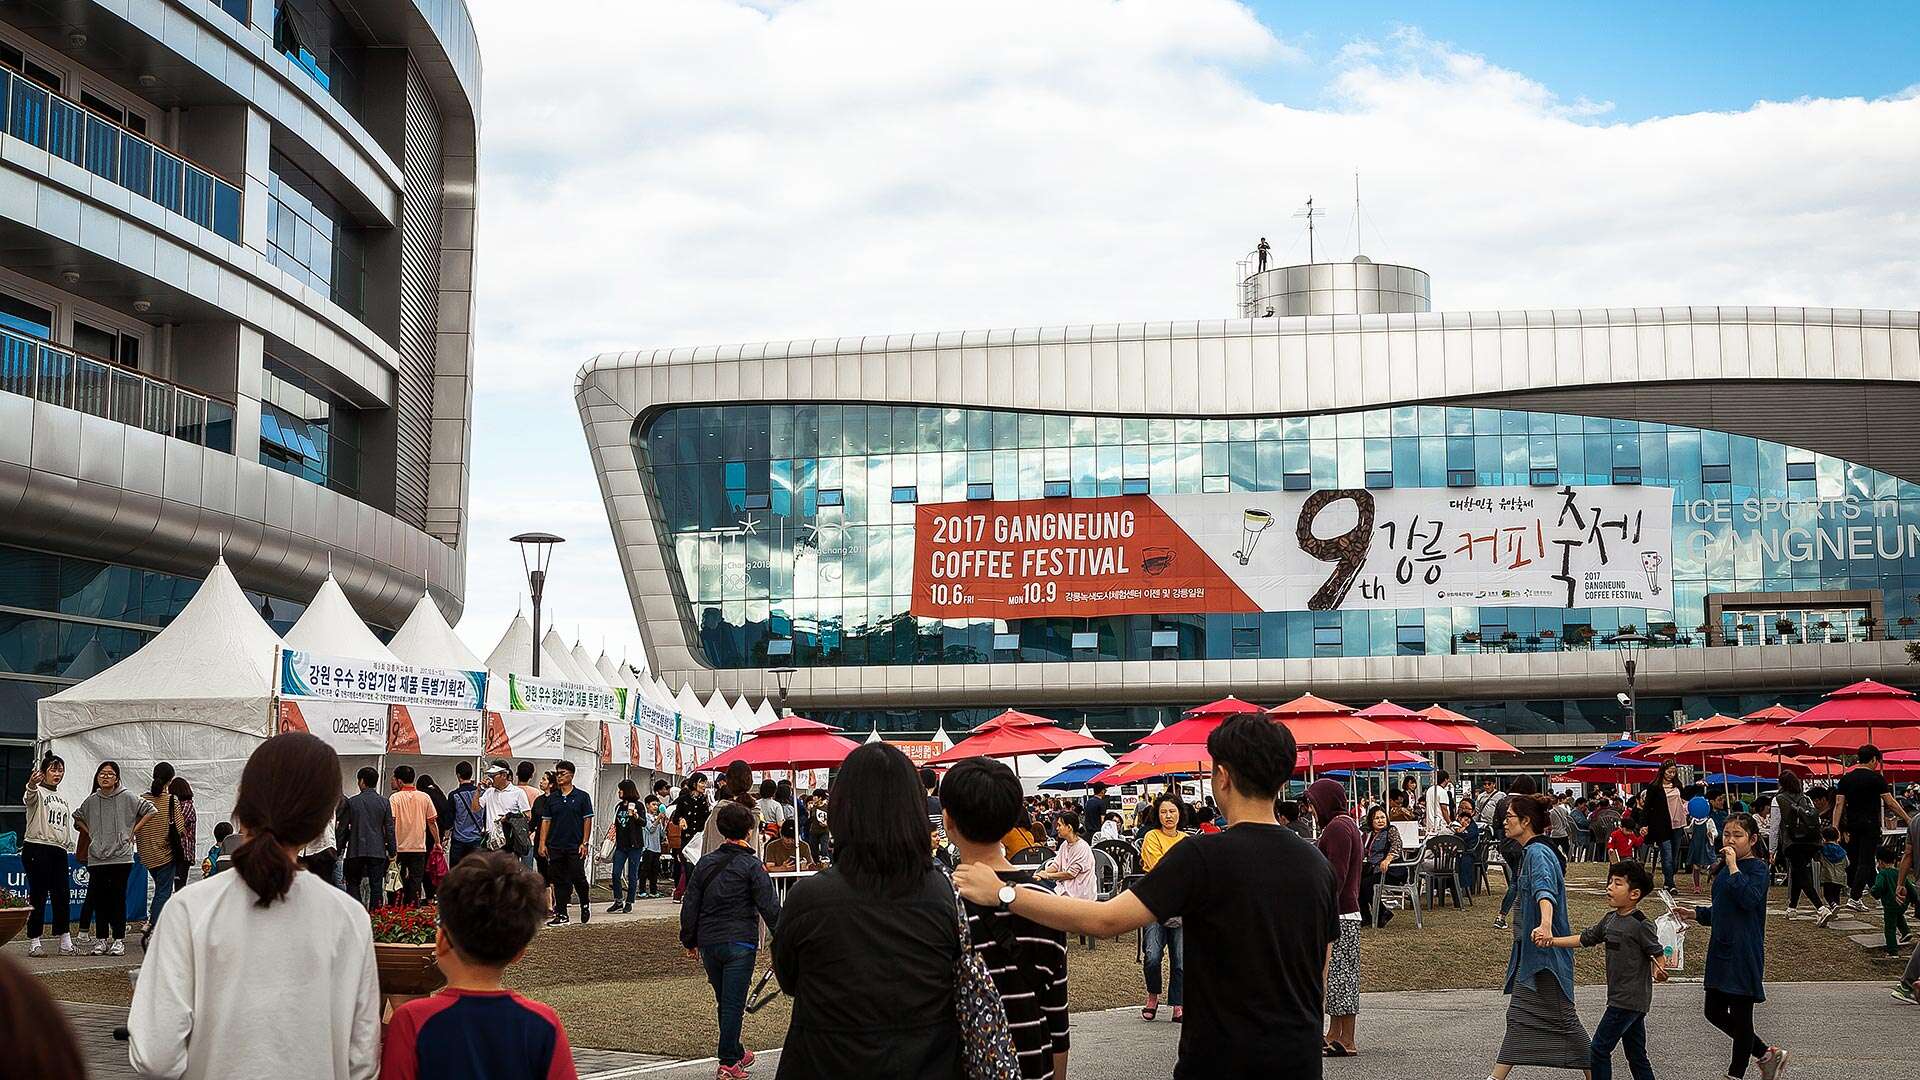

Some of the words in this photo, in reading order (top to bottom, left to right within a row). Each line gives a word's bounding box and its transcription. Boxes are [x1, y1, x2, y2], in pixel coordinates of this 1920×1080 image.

[1449, 496, 1493, 513] 대한민국
[1685, 499, 1731, 523] ICE
[1742, 495, 1861, 522] SPORTS
[1873, 495, 1899, 518] in
[932, 514, 986, 544] 2017
[993, 510, 1135, 544] GANGNEUNG
[1454, 517, 1545, 570] 커피
[1550, 486, 1643, 608] 축제
[931, 549, 1014, 579] COFFEE
[1021, 546, 1130, 578] FESTIVAL
[1584, 581, 1626, 590] GANGNEUNG
[1585, 572, 1601, 580] 2017
[930, 583, 963, 605] 10.6
[963, 595, 974, 604] FRI
[1008, 595, 1024, 605] MON
[1023, 582, 1056, 604] 10.9
[1585, 590, 1610, 600] COFFEE
[1611, 590, 1643, 600] FESTIVAL
[309, 664, 331, 686] 강원
[333, 666, 355, 688] 우수
[358, 670, 397, 692] 창업기업
[399, 674, 419, 695] 제품
[421, 677, 466, 698] 특별기획전
